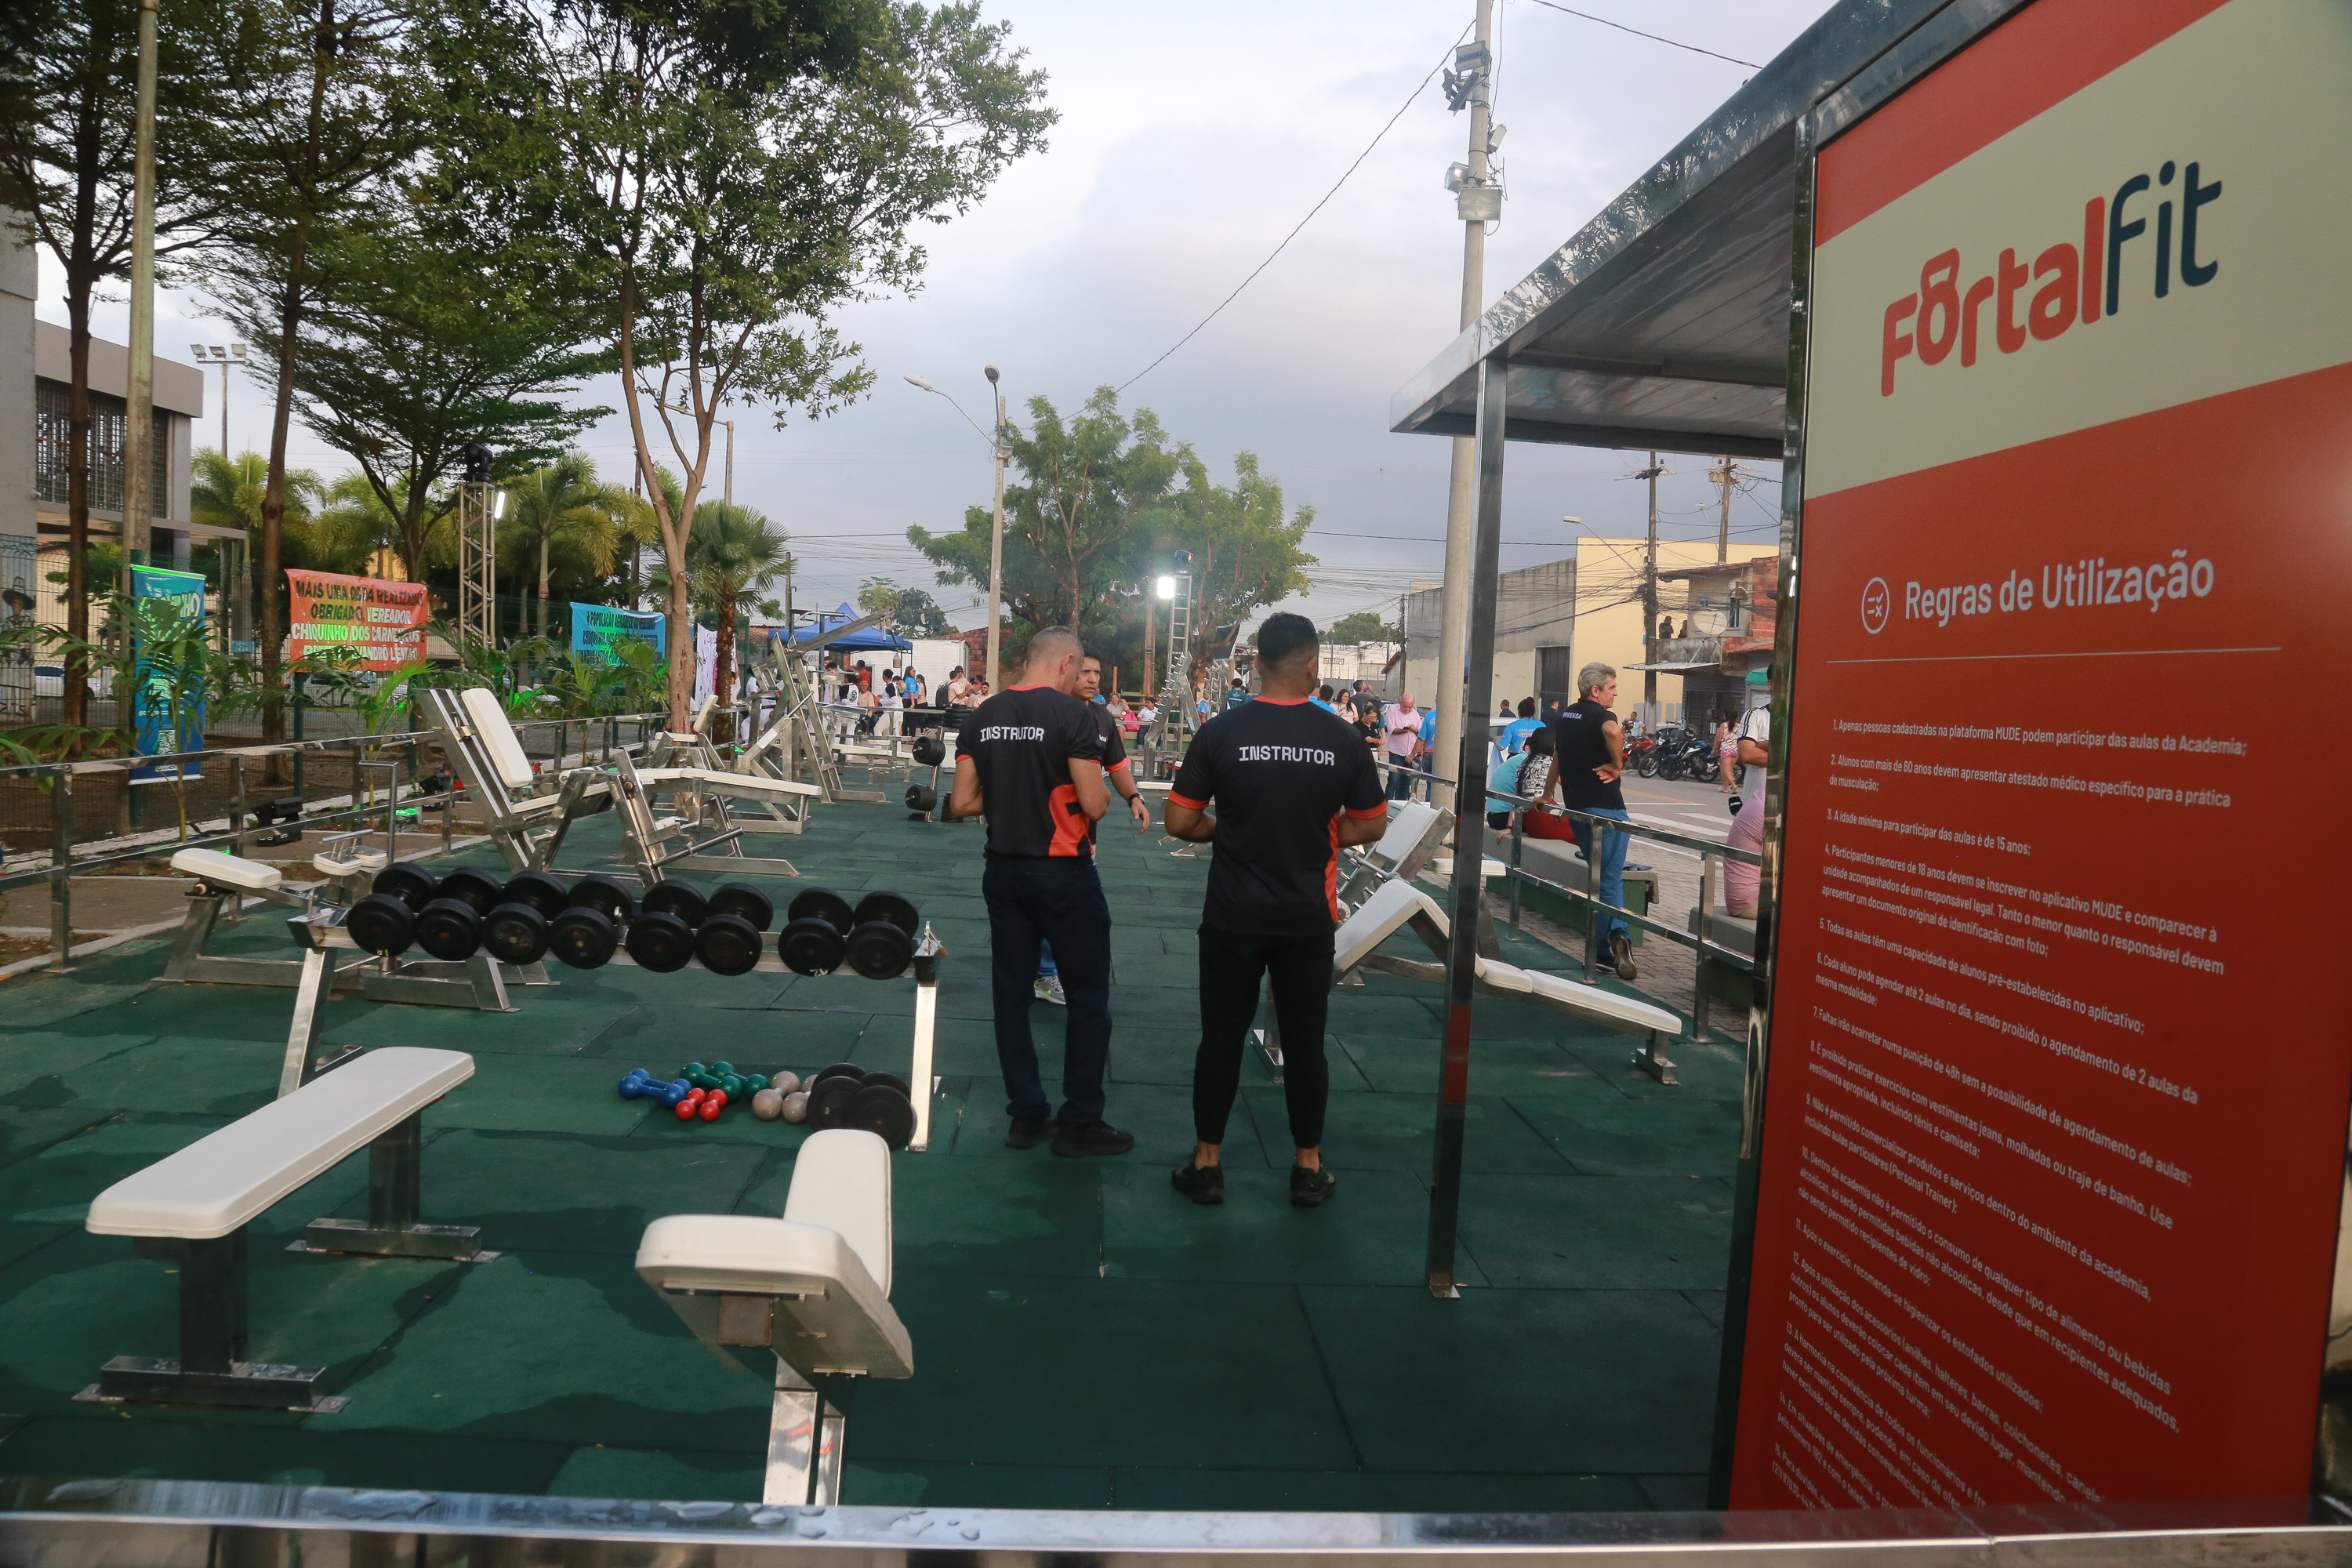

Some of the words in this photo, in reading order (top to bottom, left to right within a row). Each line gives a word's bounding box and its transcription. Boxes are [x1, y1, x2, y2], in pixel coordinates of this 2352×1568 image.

[296, 580, 324, 599] MAIS
[1905, 581, 1991, 627] Regras
[1999, 569, 2033, 612] de
[2042, 549, 2214, 613] Utilização
[292, 622, 348, 643] CHIQUINHO
[350, 625, 371, 642] DOS
[367, 606, 412, 625] VEREADOR
[980, 725, 1045, 742] INSTRUTOR
[1239, 745, 1335, 766] INSTRUTOR
[1838, 719, 1862, 733] Apenas
[1863, 723, 1891, 734] pessoas
[1892, 722, 1936, 736] cadastradas
[1938, 727, 1947, 736] na
[1949, 724, 1994, 740] plataforma
[1995, 726, 2021, 741] MUDE
[2022, 728, 2055, 744] podem
[2056, 730, 2106, 749] participar
[2107, 732, 2127, 747] das
[2129, 733, 2159, 750] aulas
[2161, 735, 2176, 750] da
[2179, 735, 2247, 756] Academia;
[1829, 775, 1838, 786] de
[1838, 778, 1879, 792] musculação;
[1831, 753, 1836, 765] 2.
[1838, 754, 1860, 768] Alunos
[1860, 759, 1875, 768] com
[1875, 759, 1892, 771] mais
[1893, 760, 1903, 772] de
[1903, 760, 1913, 773] 60
[1914, 764, 1932, 775] anos
[1933, 763, 1959, 778] devem
[1960, 768, 2007, 782] apresentar
[2008, 771, 2049, 787] atestado
[2050, 775, 2086, 791] médico
[2088, 781, 2144, 797] específico
[2146, 786, 2173, 802] para
[2185, 789, 2230, 808] prática
[1827, 808, 1832, 820] 3.
[1839, 811, 1857, 825] idade
[1858, 815, 1882, 829] mínima
[1883, 820, 1900, 832] para
[1900, 823, 1937, 839] participar
[1938, 827, 1952, 841] das
[1954, 830, 1976, 845] aulas
[1984, 834, 1994, 849] de
[1997, 836, 2005, 851] 15
[2006, 841, 2031, 856] anos;
[1824, 844, 1830, 855] 4.
[1831, 844, 1875, 865] Participantes
[1875, 856, 1906, 872] menores
[1907, 861, 1917, 874] de
[1918, 862, 1926, 876] 18
[1926, 867, 1946, 880] anos
[1947, 869, 1974, 887] devem
[1975, 877, 1986, 889] se
[1987, 877, 2028, 898] inscrever
[2029, 889, 2041, 902] no
[2042, 891, 2090, 913] aplicativo
[2092, 899, 2123, 921] MUDE
[2134, 913, 2207, 939] comparecer
[1822, 886, 1856, 902] apresentar
[1857, 895, 1867, 906] um
[1867, 896, 1907, 916] documento
[1907, 908, 1936, 924] original
[1937, 914, 1948, 927] de
[1949, 916, 2004, 943] identificação
[2005, 935, 2025, 949] com
[2027, 937, 2049, 957] foto;
[1823, 865, 1848, 880] unidade
[1848, 872, 1900, 892] acompanhados
[1900, 882, 1910, 895] de
[1911, 887, 1923, 898] um
[1924, 890, 1972, 910] responsável
[1973, 898, 1995, 916] legal.
[1998, 904, 2023, 923] Tanto
[2031, 916, 2063, 933] menor
[2063, 924, 2100, 943] quanto
[2111, 935, 2180, 964] responsável
[2181, 950, 2224, 975] devem
[1816, 974, 1838, 990] mesma
[1838, 982, 1878, 1007] modalidade;
[1820, 917, 1825, 929] 5.
[1827, 920, 1845, 936] Todas
[1845, 928, 1853, 938] as
[1853, 931, 1871, 945] aulas
[1872, 935, 1886, 949] têm
[1886, 941, 1902, 954] uma
[1903, 946, 1947, 968] capacidade
[1947, 958, 1958, 972] de
[1959, 963, 1987, 982] alunos
[1988, 973, 2071, 1009] pré-estabelecidas
[2073, 1000, 2086, 1014] no
[2088, 1005, 2144, 1035] aplicativo;
[1817, 952, 1823, 964] 6.
[1824, 954, 1839, 970] Cada
[1839, 961, 1857, 976] aluno
[1857, 969, 1875, 983] pode
[1875, 975, 1904, 993] agendar
[1905, 985, 1918, 999] até
[1924, 993, 1945, 1009] aulas
[1946, 1000, 1957, 1013] no
[1958, 1004, 1973, 1020] dia,
[1974, 1011, 2000, 1029] sendo
[2002, 1021, 2039, 1044] proibido
[2049, 1039, 2120, 1075] agendamento
[2122, 1063, 2136, 1081] de
[2147, 1076, 2180, 1098] aulas
[2182, 1086, 2198, 1105] da
[1819, 1008, 1837, 1026] Faltas
[1838, 1017, 1850, 1032] irão
[1850, 1025, 1882, 1045] acarretar
[1882, 1039, 1902, 1055] numa
[1903, 1047, 1933, 1069] punição
[1933, 1059, 1944, 1073] de
[1945, 1063, 1961, 1080] 48h
[1962, 1073, 1980, 1089] sem
[1987, 1084, 2047, 1120] possibilidade
[2049, 1109, 2062, 1127] de
[2063, 1118, 2136, 1160] agendamento
[2138, 1150, 2154, 1168] de
[2155, 1160, 2191, 1185] aulas;
